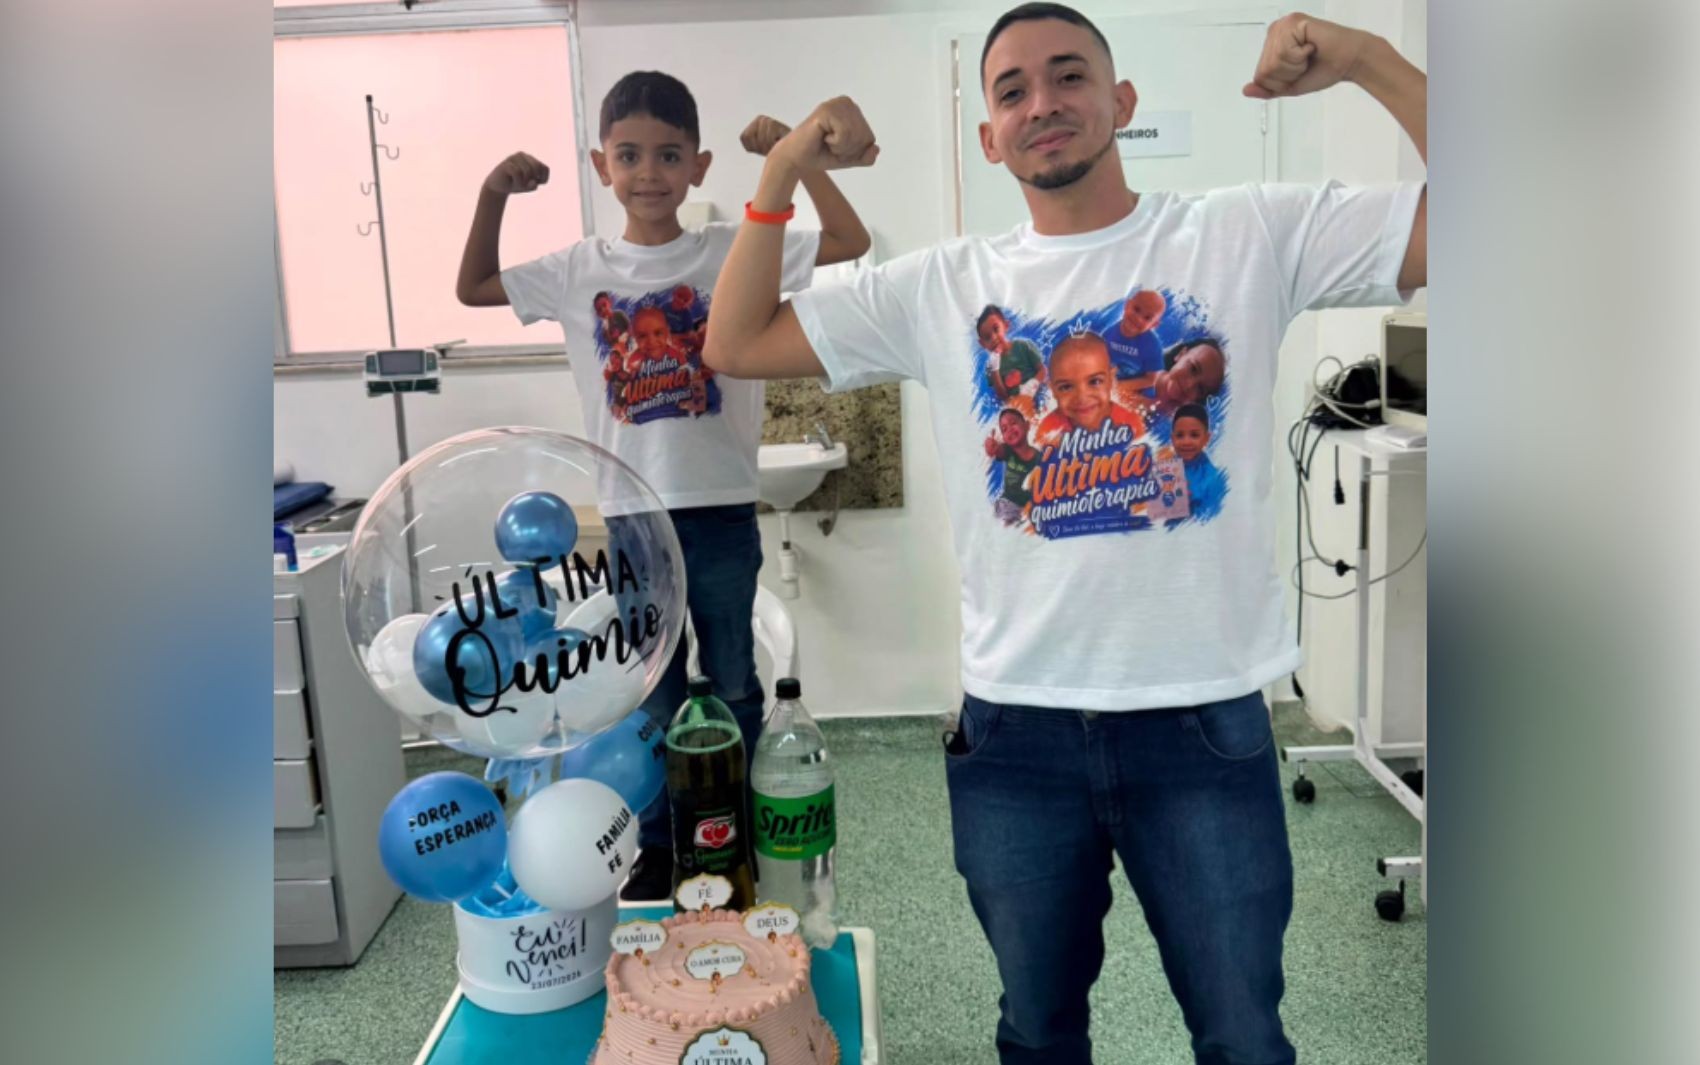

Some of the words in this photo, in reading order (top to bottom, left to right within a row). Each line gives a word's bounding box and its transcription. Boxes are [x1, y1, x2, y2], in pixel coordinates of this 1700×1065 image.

[1059, 419, 1131, 458] Minha
[1026, 444, 1150, 503] Última
[1031, 478, 1157, 530] quimioterapia
[452, 549, 639, 628] ÚLTIMA
[445, 604, 664, 718] Quimio
[414, 810, 497, 855] ESPERANÇA
[595, 806, 632, 855] FAMÍLIA
[760, 802, 834, 841] Sprite
[607, 850, 623, 874] FÉ
[697, 885, 714, 899] FÉ
[511, 925, 562, 953] Eu
[616, 933, 661, 945] FAMÍLIA
[756, 916, 789, 929] DEUS
